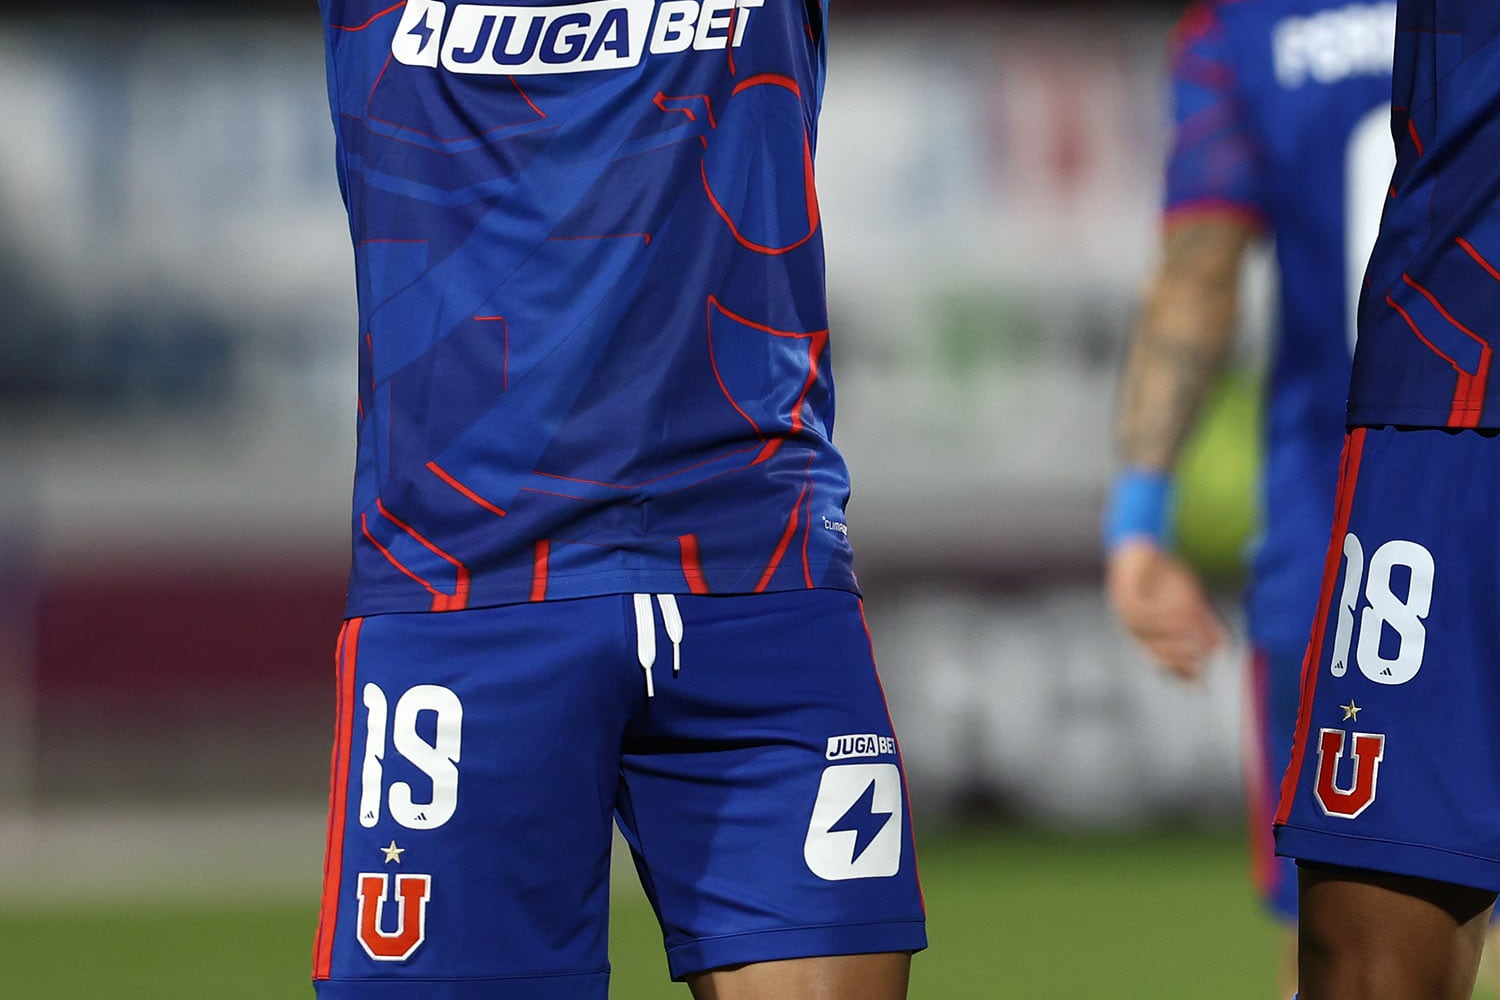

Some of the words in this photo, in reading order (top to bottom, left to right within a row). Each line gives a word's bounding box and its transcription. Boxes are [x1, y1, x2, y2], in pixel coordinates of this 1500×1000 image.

[1330, 532, 1436, 685] 18
[359, 682, 464, 830] 19
[1313, 728, 1385, 820] U
[356, 872, 431, 961] U
